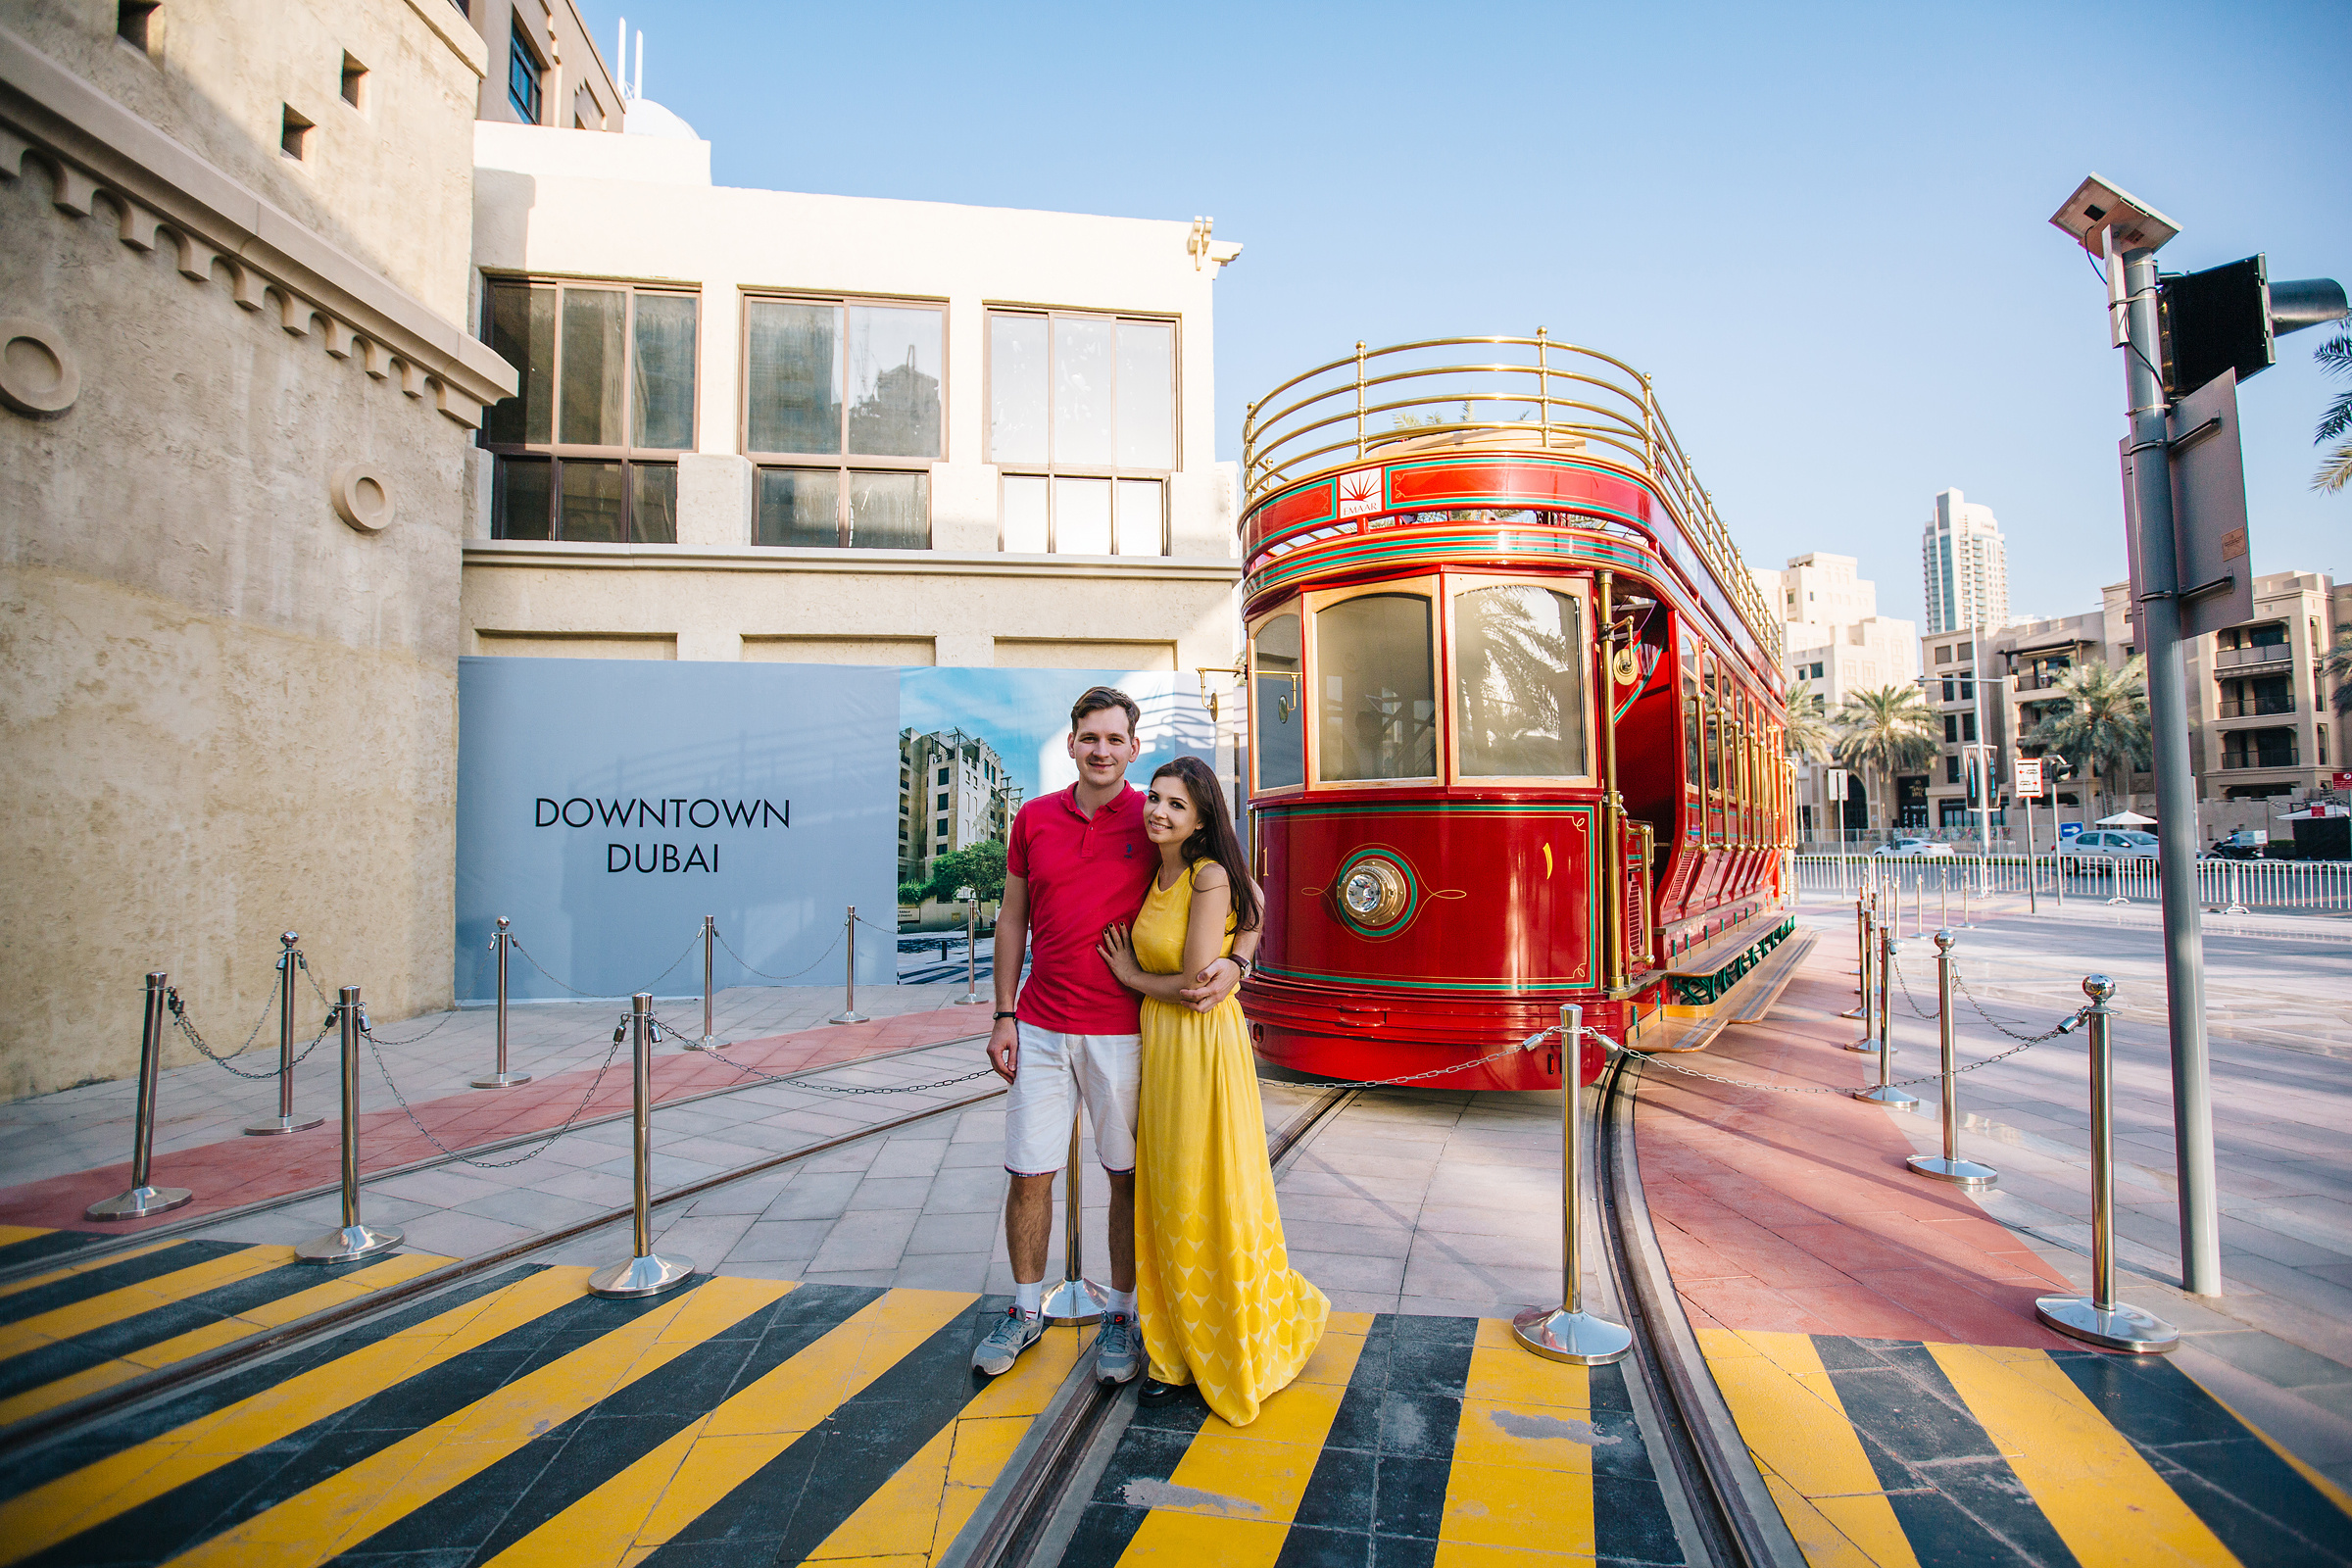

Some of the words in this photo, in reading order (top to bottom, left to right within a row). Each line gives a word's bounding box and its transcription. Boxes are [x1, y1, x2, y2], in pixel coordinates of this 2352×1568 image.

[1344, 502, 1377, 515] EMAAR
[535, 798, 790, 829] DOWNTOWN
[607, 843, 718, 873] DUBAI
[1263, 847, 1269, 876] 1
